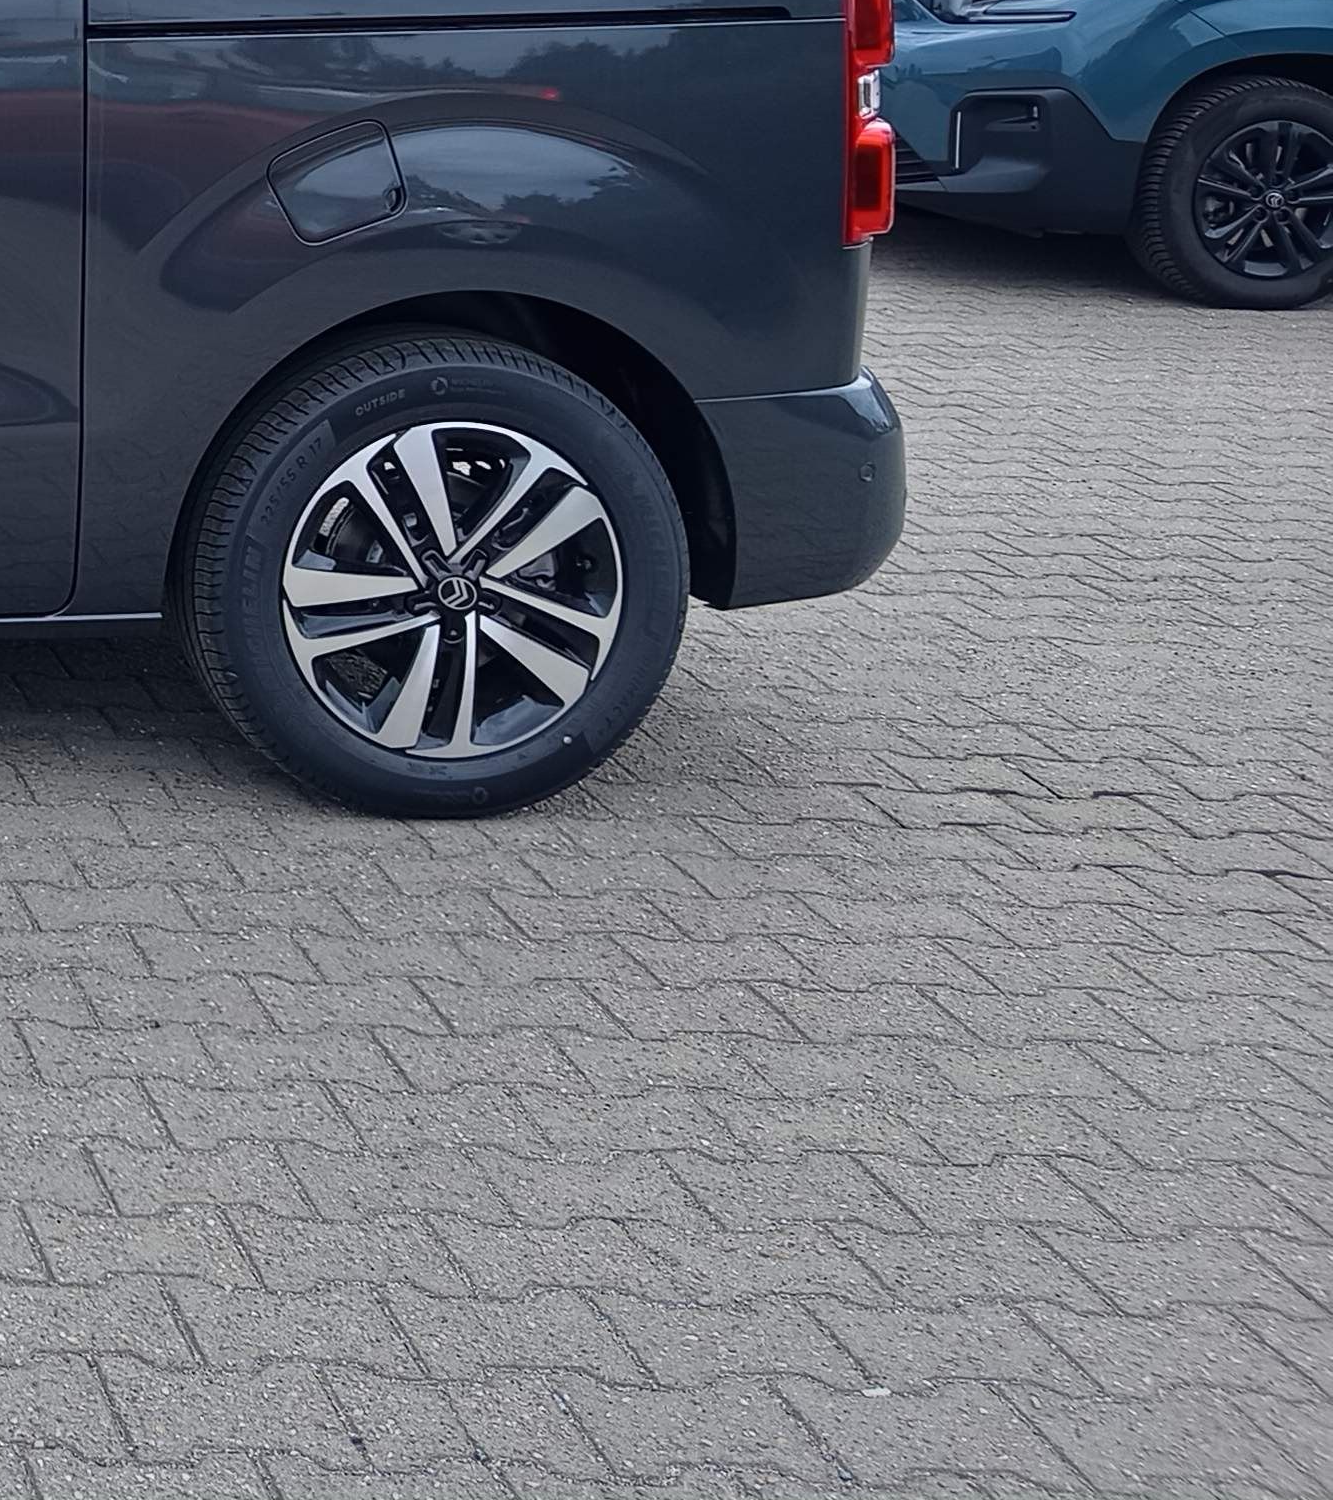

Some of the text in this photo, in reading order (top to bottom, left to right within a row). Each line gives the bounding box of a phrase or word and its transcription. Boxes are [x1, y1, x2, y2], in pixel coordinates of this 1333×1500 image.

[354, 388, 406, 417] OUTSIDE
[260, 467, 298, 526] 225/55
[295, 455, 309, 469] R
[308, 437, 322, 455] 17
